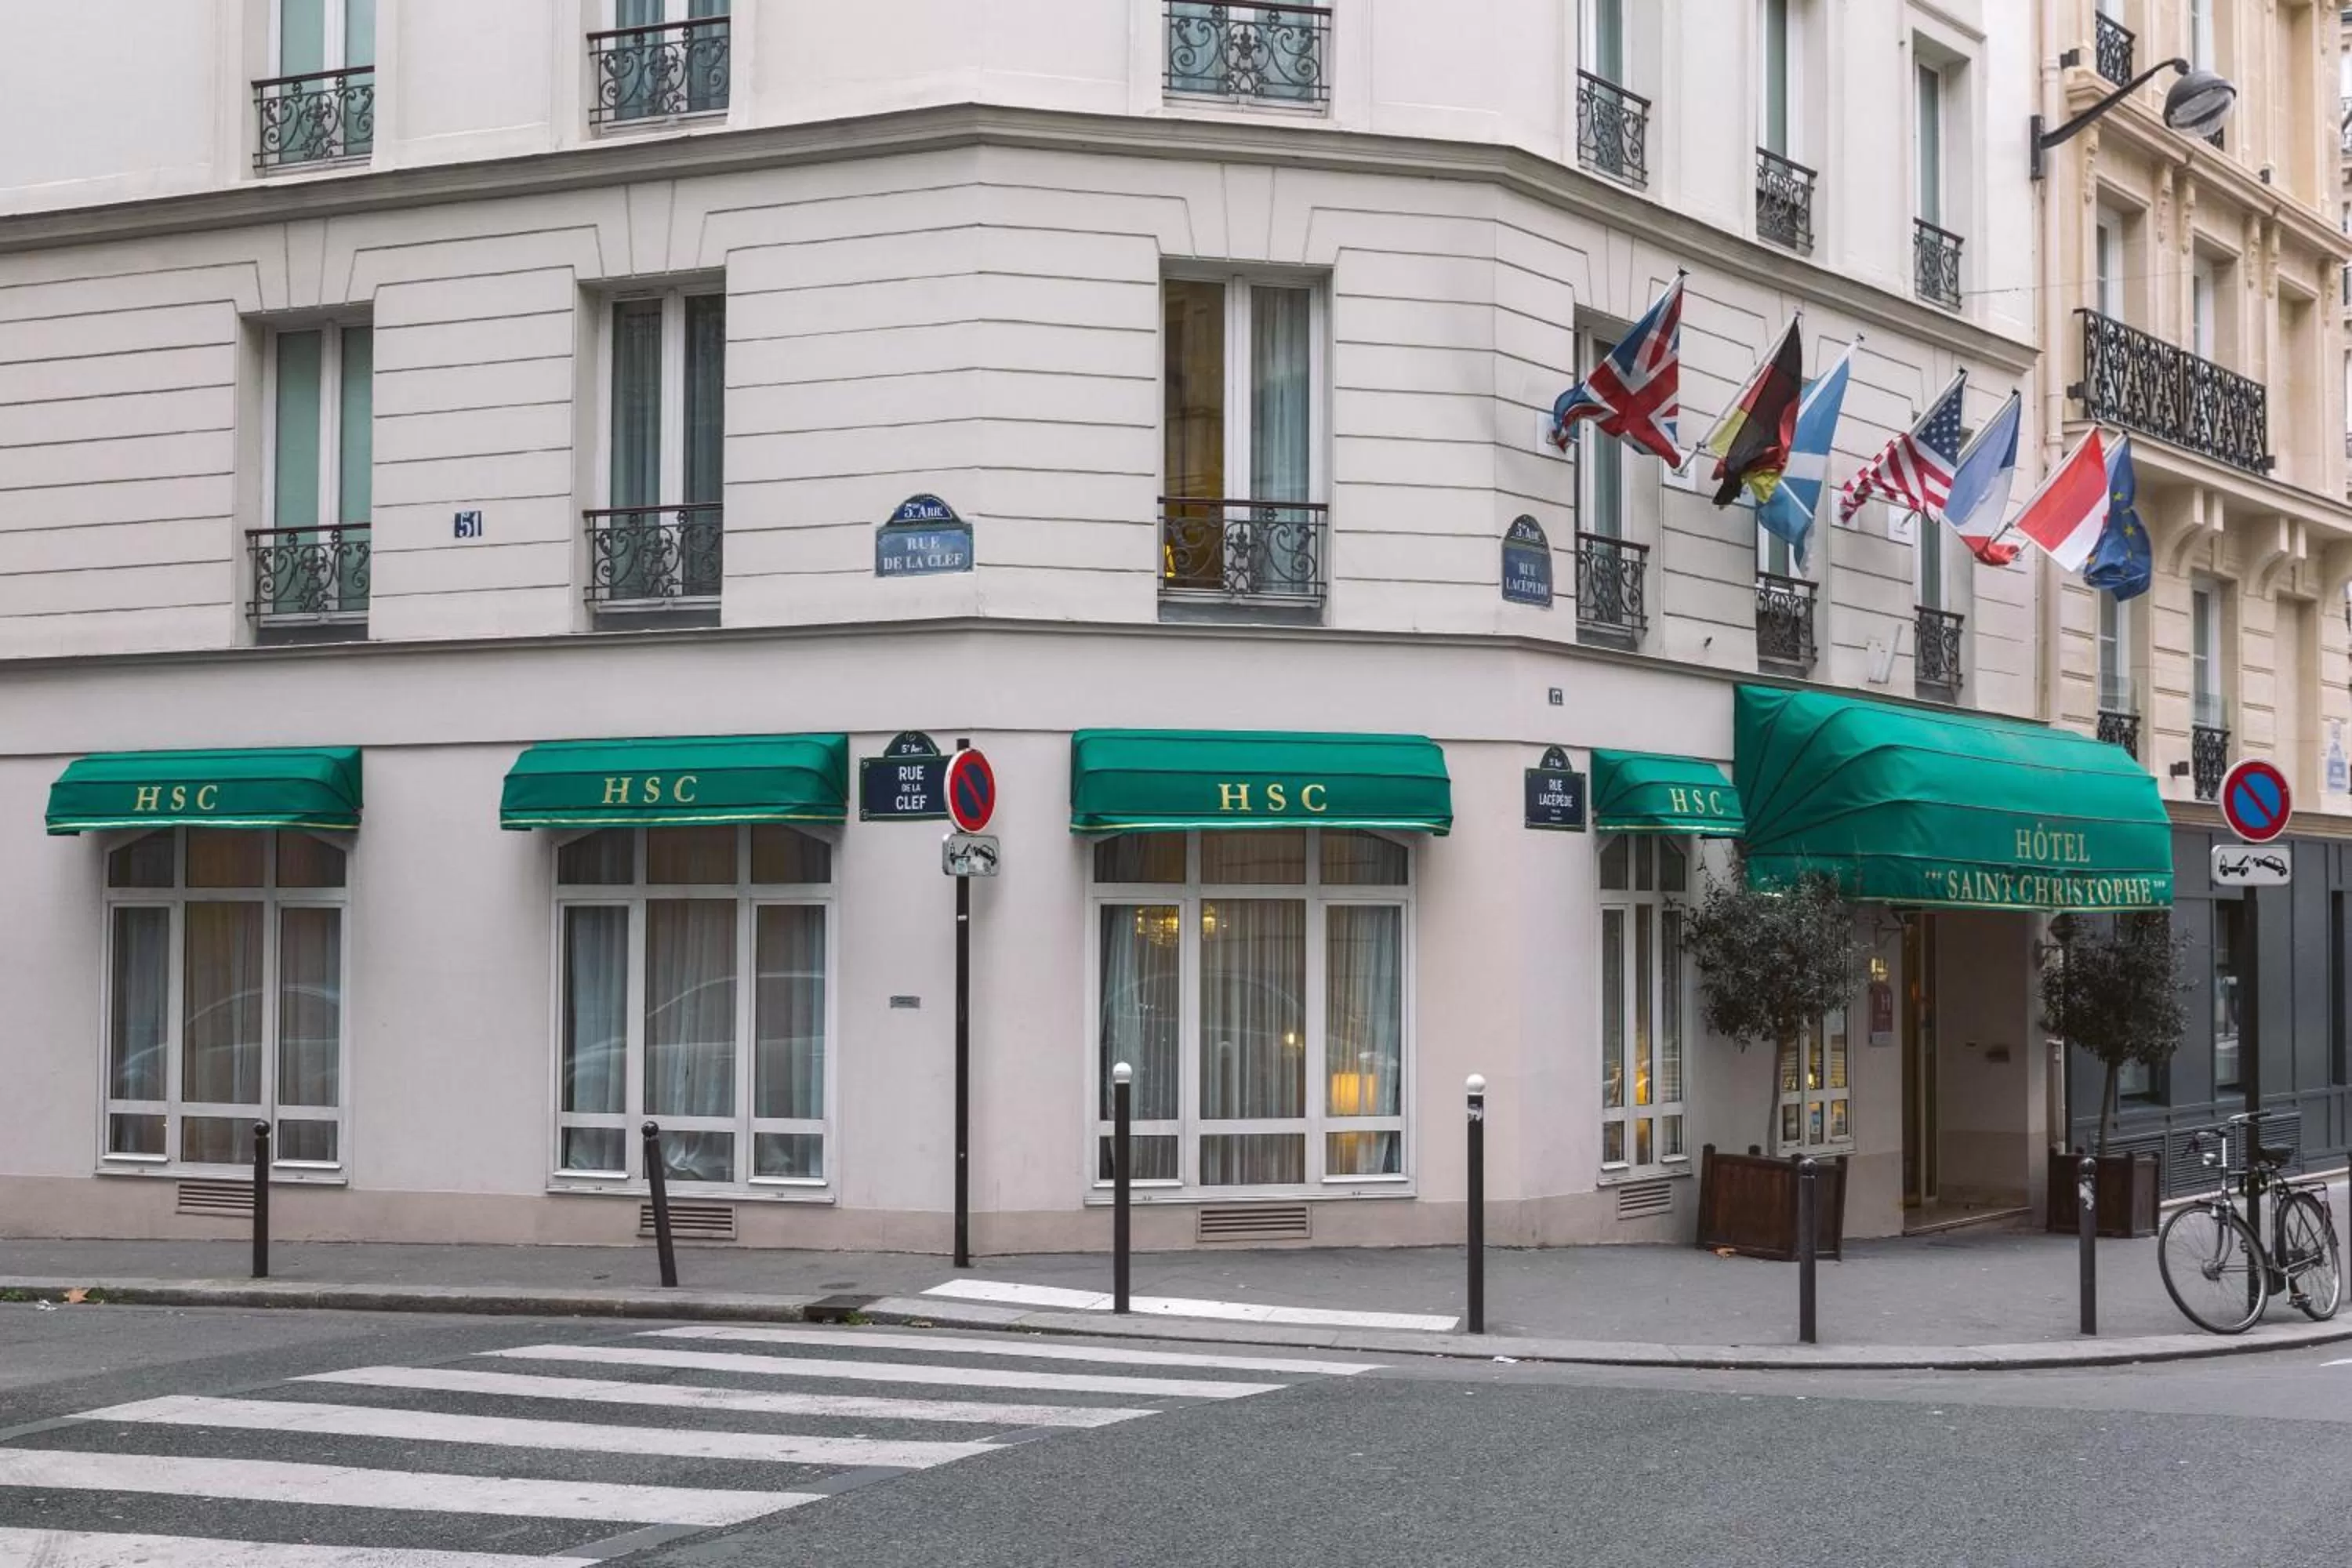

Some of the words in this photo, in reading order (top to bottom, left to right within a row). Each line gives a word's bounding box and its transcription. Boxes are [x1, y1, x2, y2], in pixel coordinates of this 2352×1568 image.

[460, 511, 478, 538] 51
[907, 536, 940, 550] RUE
[884, 557, 901, 570] DE
[906, 555, 923, 568] LA
[927, 553, 964, 567] CLEF
[1519, 562, 1536, 576] RUE
[898, 765, 924, 781] RUE
[1548, 779, 1563, 791] RUE
[895, 795, 927, 811] CLEF
[2015, 822, 2091, 862] HÔTEL
[1947, 868, 2014, 902] SAINT
[2016, 874, 2152, 906] CHRISTOPHE
